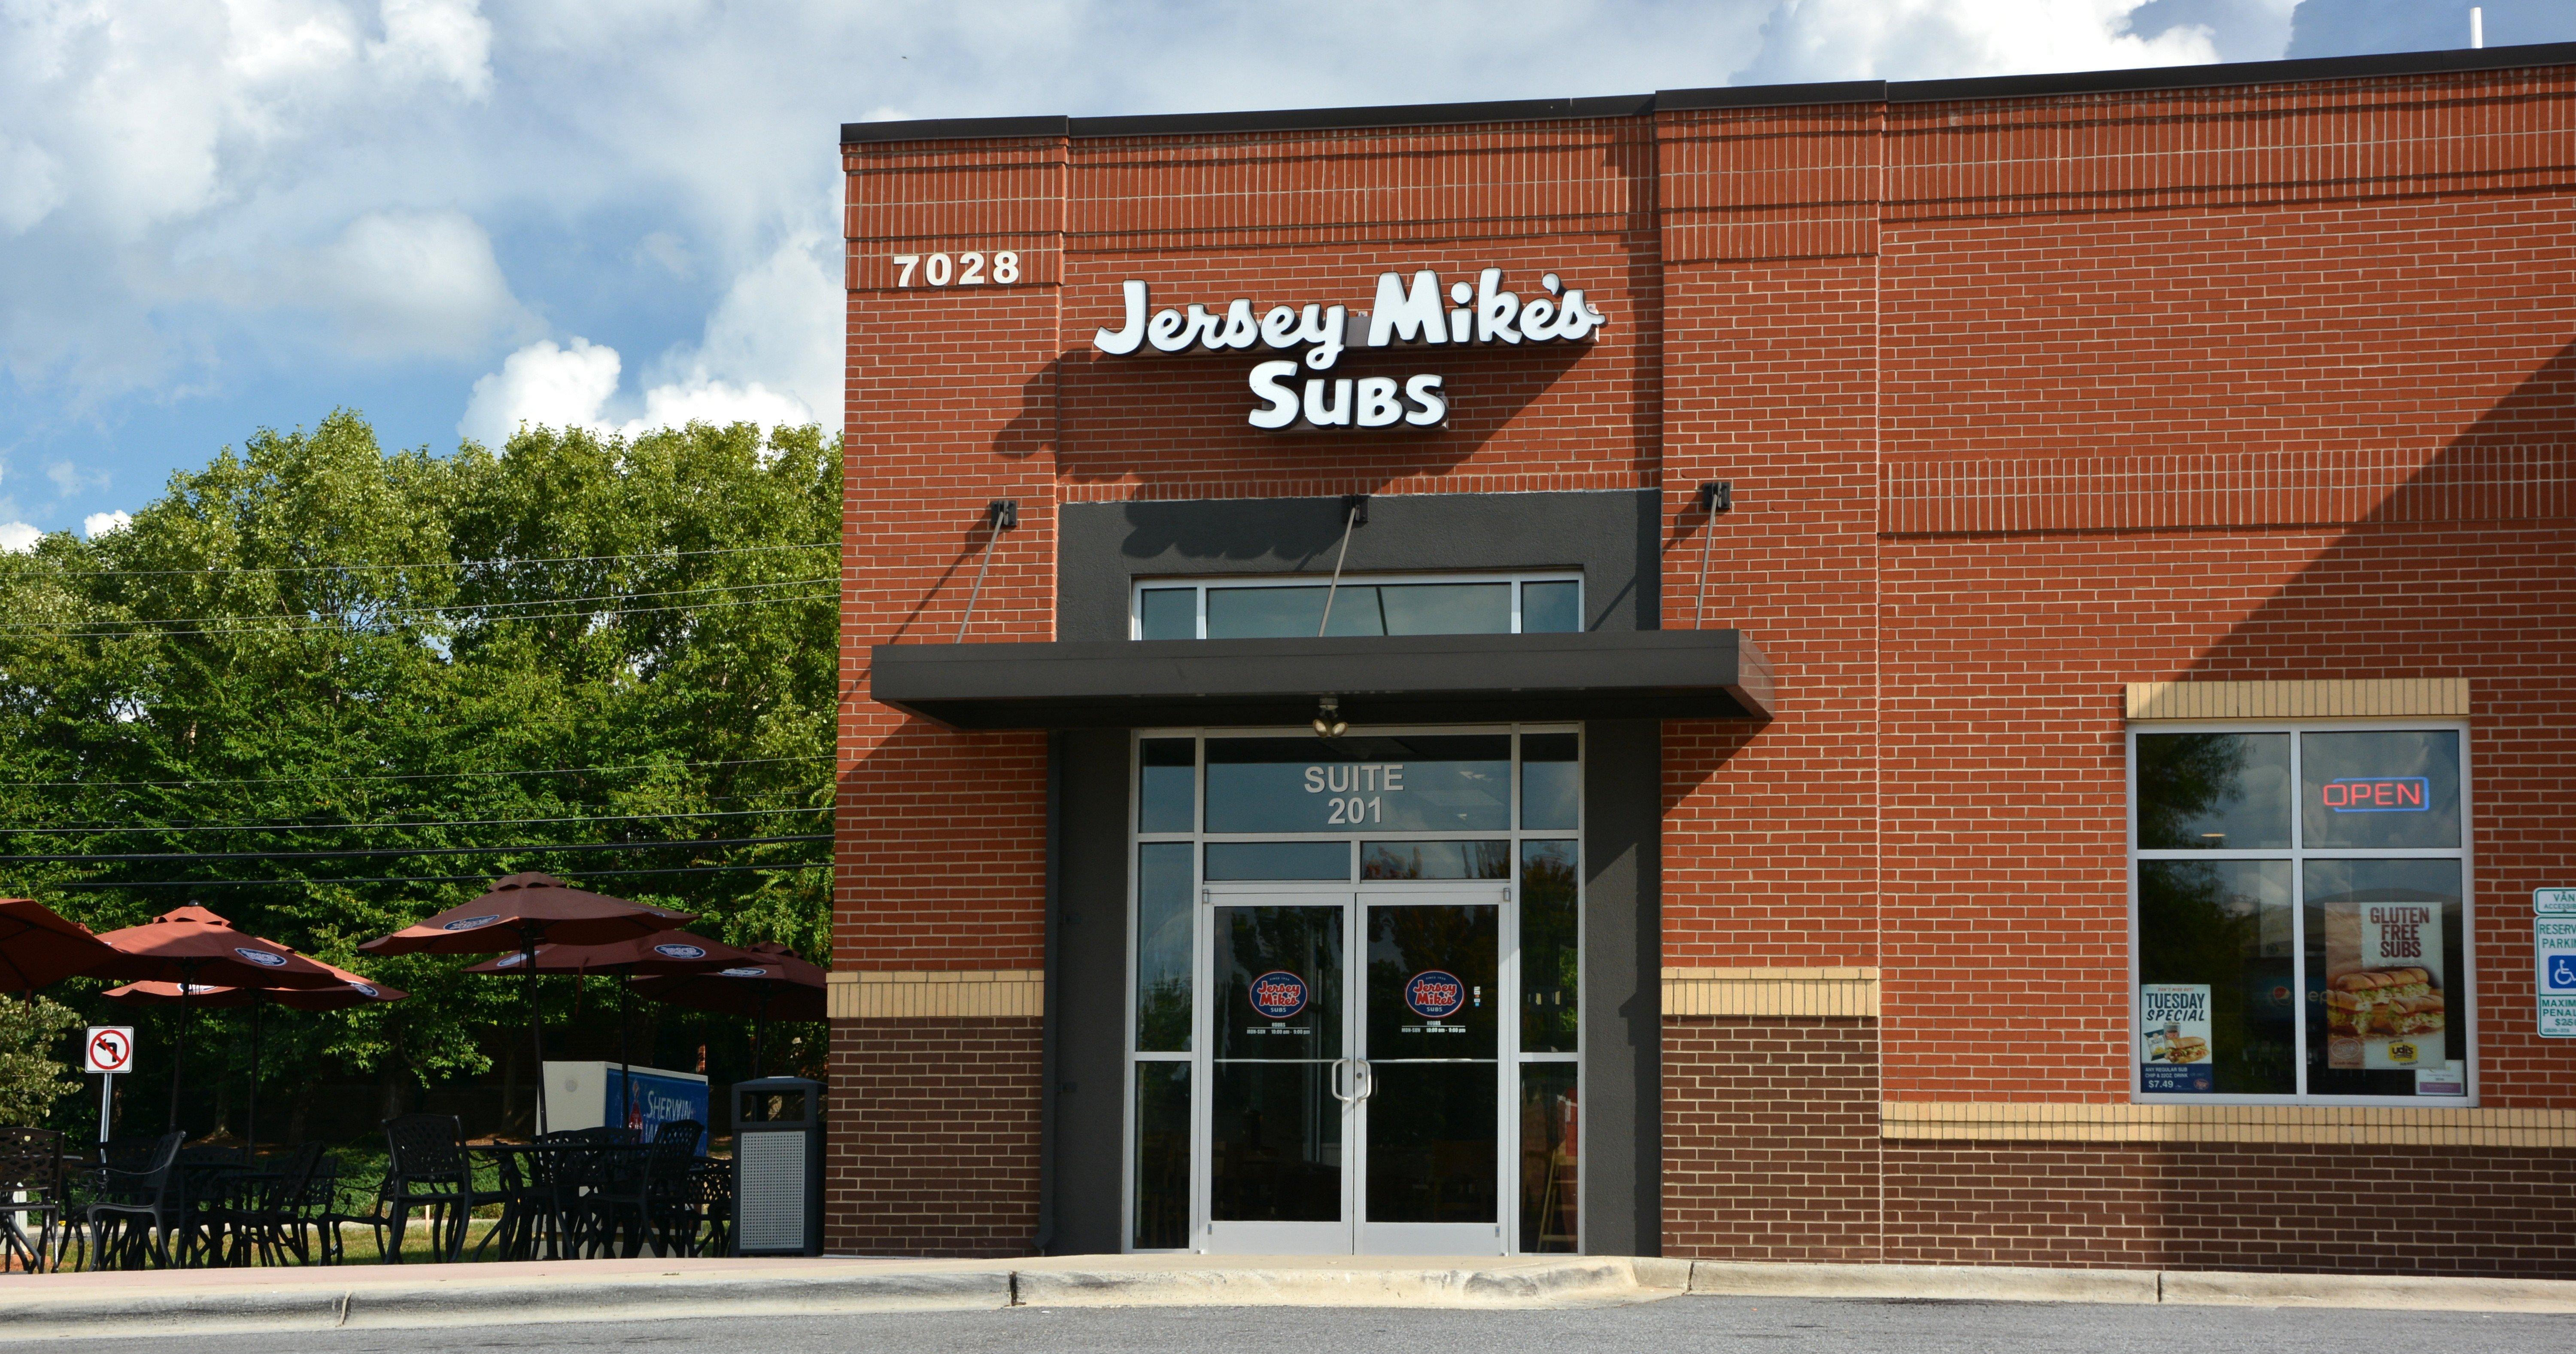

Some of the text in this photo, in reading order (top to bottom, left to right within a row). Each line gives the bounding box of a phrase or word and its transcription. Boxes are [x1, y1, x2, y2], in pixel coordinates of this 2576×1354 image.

[893, 251, 1019, 287] 7028
[1093, 267, 1606, 370] Jersey Mike's
[1248, 360, 1447, 429] SUBS
[1304, 764, 1404, 793] SUITE
[2322, 783, 2421, 806] OPEN
[1327, 796, 1381, 824] 201
[2553, 893, 2575, 902] VAN
[2370, 907, 2430, 924] GLUTEN
[2381, 924, 2420, 941] FREE
[2380, 941, 2421, 958] SUBS
[1257, 981, 1301, 997] Jersey
[1413, 980, 1457, 996] Jersey
[1259, 993, 1300, 1006] Mike's
[1415, 992, 1456, 1006] Mike's
[2146, 993, 2205, 1009] TUESDAY
[2146, 1009, 2205, 1021] SPECIAL
[2148, 1079, 2174, 1088] $7.49
